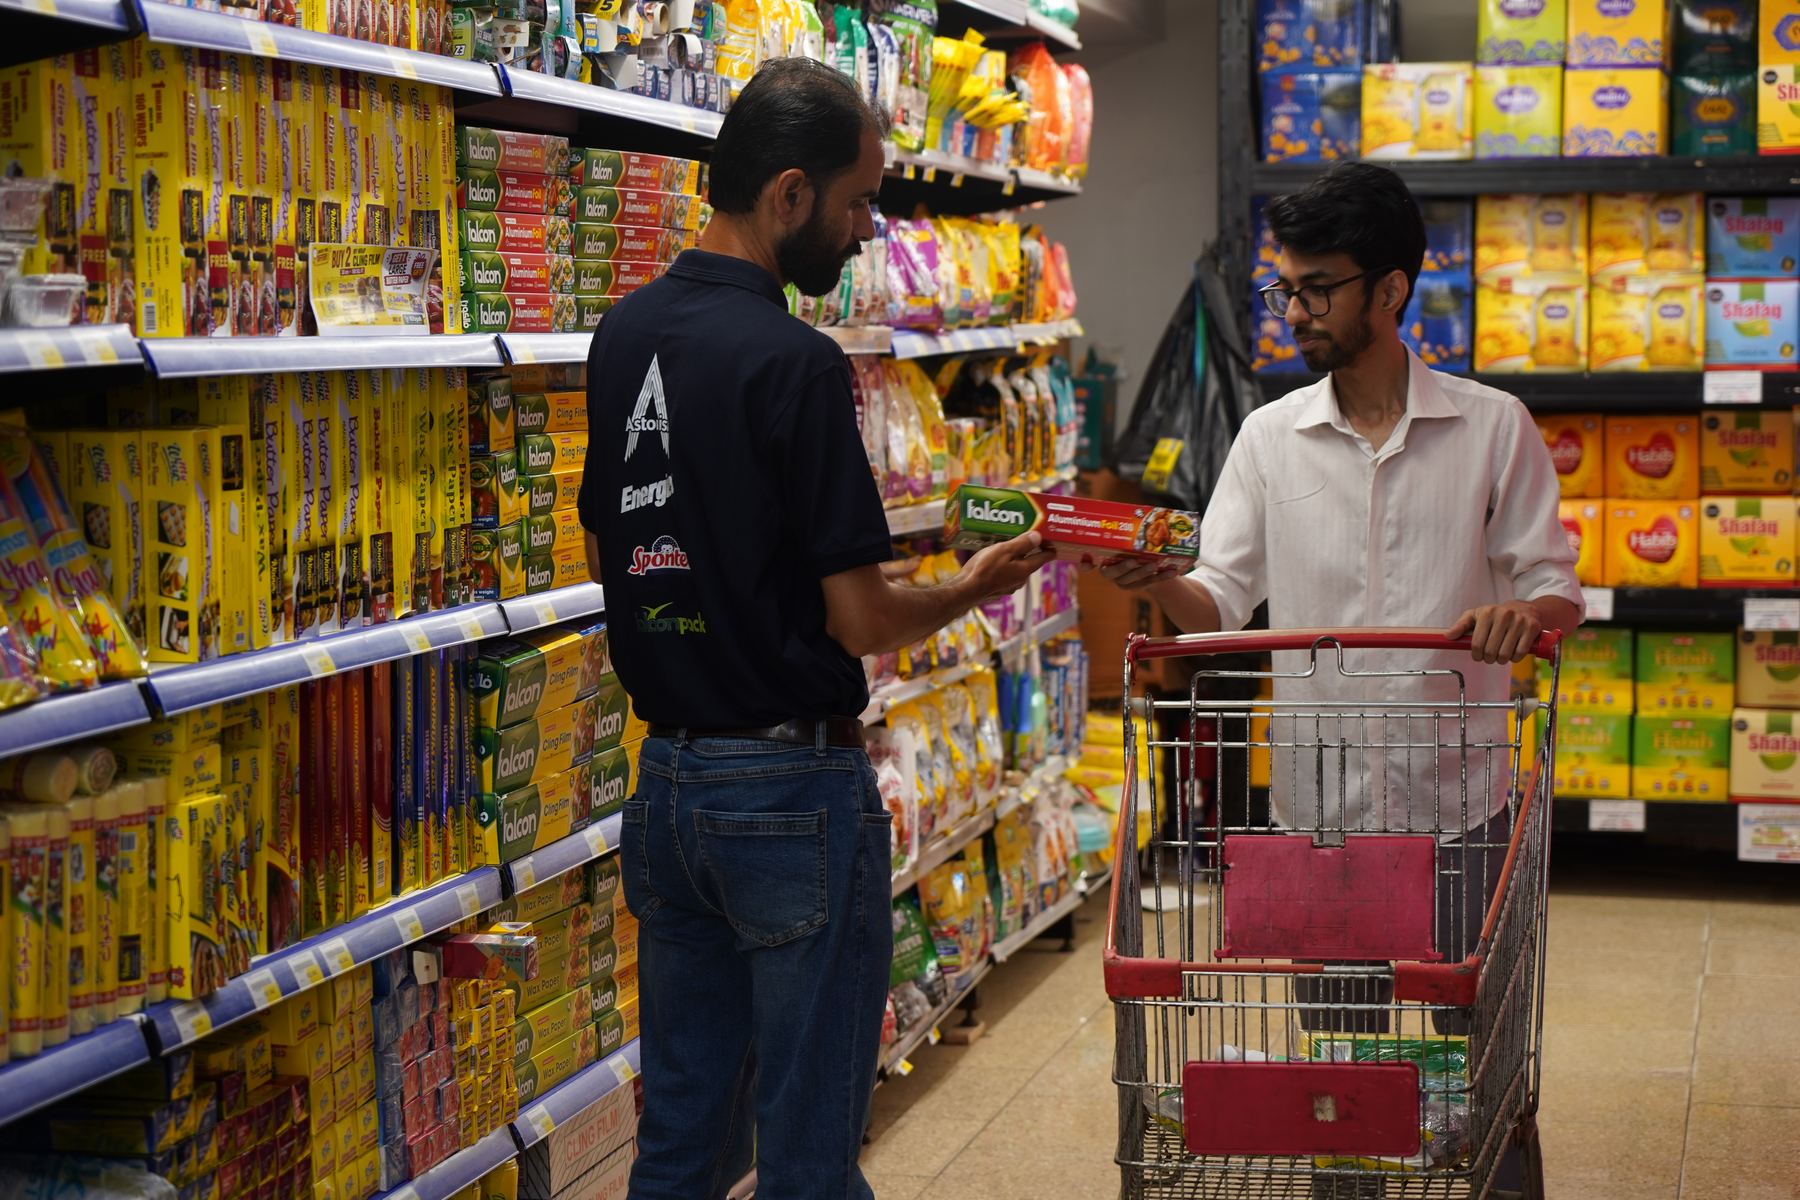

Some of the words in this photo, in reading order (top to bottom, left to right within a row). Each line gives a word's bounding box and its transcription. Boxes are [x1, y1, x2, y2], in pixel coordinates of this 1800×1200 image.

[599, 0, 613, 11] 5
[327, 115, 335, 154] Cling
[349, 126, 359, 188] Butter
[469, 136, 497, 160] falcon
[591, 160, 613, 180] falcon
[468, 179, 496, 202] falcon
[585, 196, 608, 217] falcon
[468, 220, 496, 243] falcon
[584, 233, 606, 254] falcon
[82, 249, 105, 262] FREE
[210, 254, 228, 267] FREE
[277, 256, 294, 270] FREE
[331, 249, 345, 268] BUY
[345, 246, 352, 267] 2
[353, 254, 368, 266] CLING
[368, 253, 380, 265] FILM
[389, 264, 407, 274] LARGE
[474, 261, 501, 284] falcon
[580, 270, 602, 290] falcon
[480, 303, 507, 325] falcon
[584, 306, 603, 327] falco
[1722, 303, 1783, 320] Shafaq
[492, 391, 510, 409] falcon
[518, 406, 545, 427] falcon
[557, 408, 573, 420] Cling
[575, 407, 587, 417] Film
[372, 406, 381, 471] Baking
[418, 406, 427, 457] Wax
[446, 403, 455, 454] Wax
[265, 420, 278, 486] Butter
[302, 419, 314, 486] Butter
[318, 417, 330, 482] Butter
[349, 415, 358, 482] Butter
[528, 445, 552, 467] falcon
[562, 447, 575, 458] Cling
[1551, 443, 1582, 459] abib
[1628, 446, 1674, 463] Habib
[500, 462, 516, 484] falcon
[374, 476, 383, 530] Paper
[419, 463, 428, 528] Paper
[446, 462, 457, 523] Paper
[532, 486, 553, 508] falcon
[562, 486, 575, 497] Cling
[268, 490, 280, 548] Paper
[303, 489, 315, 543] Paper
[319, 484, 331, 539] Paper
[349, 483, 360, 537] Paper
[966, 498, 1025, 525] falcon
[531, 525, 553, 547] falcon
[562, 525, 575, 536] Cling
[1718, 519, 1779, 537] Shafaq
[502, 538, 520, 558] falcon
[1630, 531, 1677, 549] Habib
[528, 565, 551, 587] falcon
[561, 563, 574, 575] Cling
[452, 589, 459, 599] 5
[462, 585, 469, 595] 5
[379, 607, 385, 617] 5
[1755, 645, 1800, 663] Shafa
[503, 680, 542, 715] falcon
[550, 670, 565, 686] Cling
[565, 665, 578, 679] Film
[275, 723, 291, 766] Zip
[1748, 733, 1800, 753] Shafa
[497, 746, 536, 779] falcon
[543, 738, 558, 751] Cling
[558, 732, 572, 745] Film
[591, 773, 624, 808] falcon
[503, 808, 538, 844] falcon
[544, 803, 557, 817] Cling
[557, 797, 569, 810] Film
[596, 873, 616, 894] falcon
[523, 899, 537, 912] Wax
[538, 893, 554, 904] Paper
[544, 932, 561, 948] Paper
[591, 953, 613, 974] falcon
[619, 942, 636, 955] Baking
[527, 983, 540, 996] Wax
[541, 976, 560, 990] Paper
[592, 989, 614, 1011] falcon
[619, 977, 635, 990] Baking
[515, 1038, 529, 1054] con
[538, 1027, 550, 1039] Wax
[550, 1018, 566, 1033] Paper
[601, 1026, 620, 1049] falcon
[543, 1066, 555, 1079] Wax
[555, 1057, 571, 1071] Paper
[566, 1125, 595, 1160] CLING
[597, 1107, 618, 1137] FILM
[609, 1175, 624, 1194] FILM
